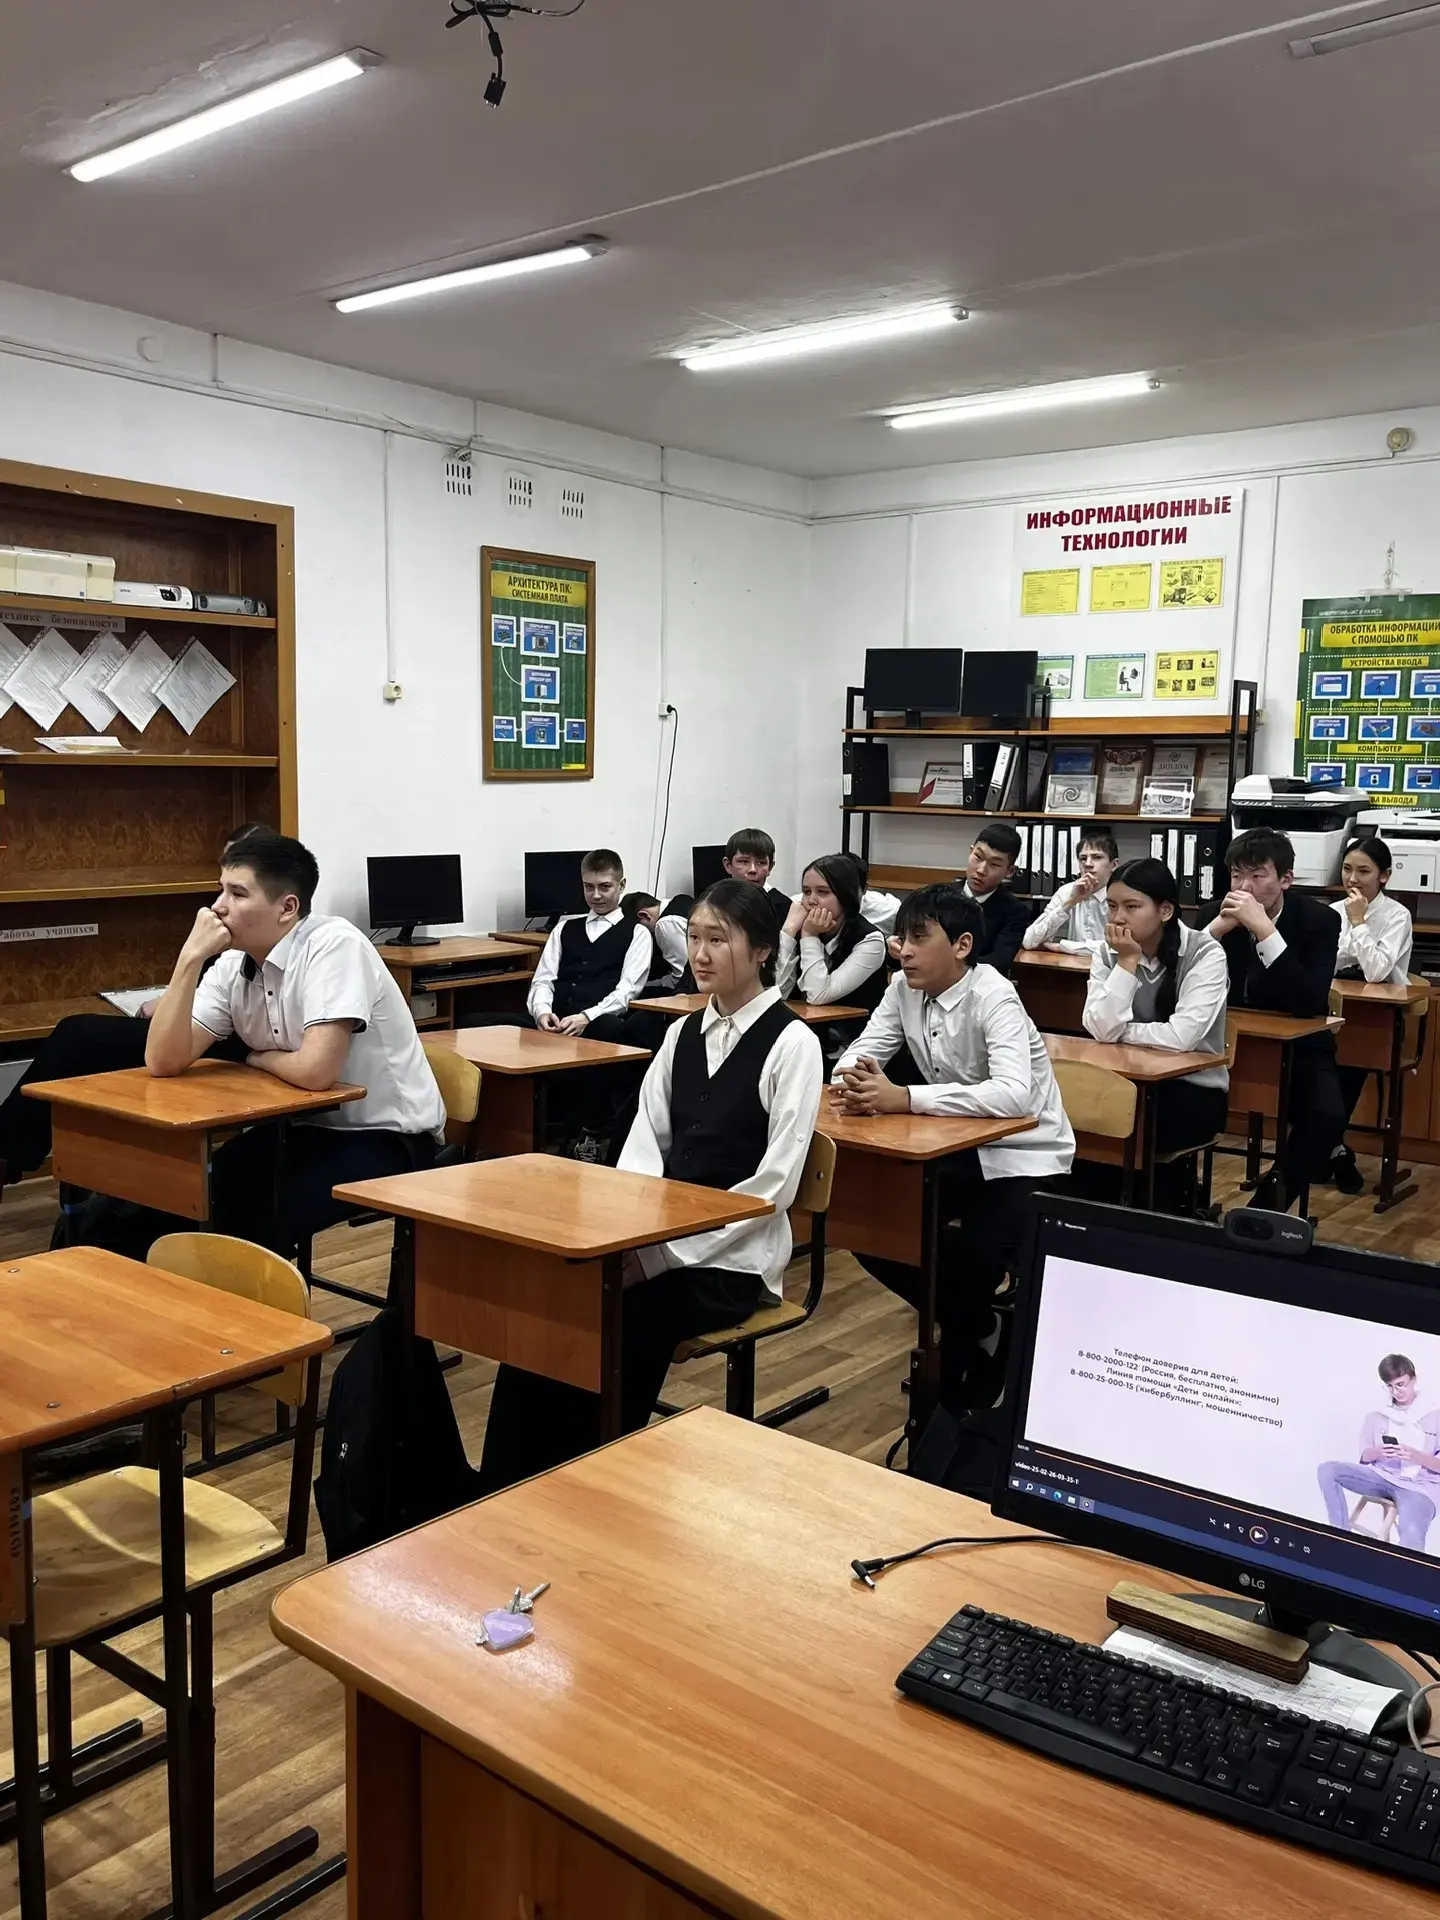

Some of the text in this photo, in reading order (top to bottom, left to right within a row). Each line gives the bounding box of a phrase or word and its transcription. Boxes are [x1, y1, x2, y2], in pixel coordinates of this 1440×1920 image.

[1026, 496, 1231, 529] ИНФОРМАЦИОННЫЕ
[1061, 526, 1187, 552] ТЕХНОЛОГИИ
[508, 576, 573, 594] АРХИТЕКТУРА ПК:
[512, 589, 568, 604] СИСТЕМНАЯ ПЛАТА
[51, 614, 118, 629] безопасности
[1330, 622, 1440, 634] ОБРАБОТКА ИНФОРМАЦИИ
[1352, 633, 1418, 644] С ПОМОЩЬЮ ПК
[1350, 658, 1422, 667] УСТРОЙСТВА ВВОДА
[1357, 745, 1403, 753] КОМПЬЮТЕР
[1383, 796, 1414, 804] ВЫВОДА
[46, 926, 95, 938] учащихся
[1281, 1230, 1304, 1239] logitech
[1114, 1348, 1239, 1384] Телефон доверия для детей:
[1078, 1350, 1280, 1406] 8-800-2000-122 (Россия, бесплатно, анонимно)
[1106, 1367, 1133, 1380] Линия
[1135, 1375, 1171, 1389] помощи
[1173, 1384, 1199, 1396] «Дети
[1070, 1368, 1134, 1390] 8-800-25-000-15
[1206, 1403, 1283, 1428] мошенничество)
[1251, 1577, 1266, 1589] LG
[1317, 1778, 1352, 1793] SVEN
